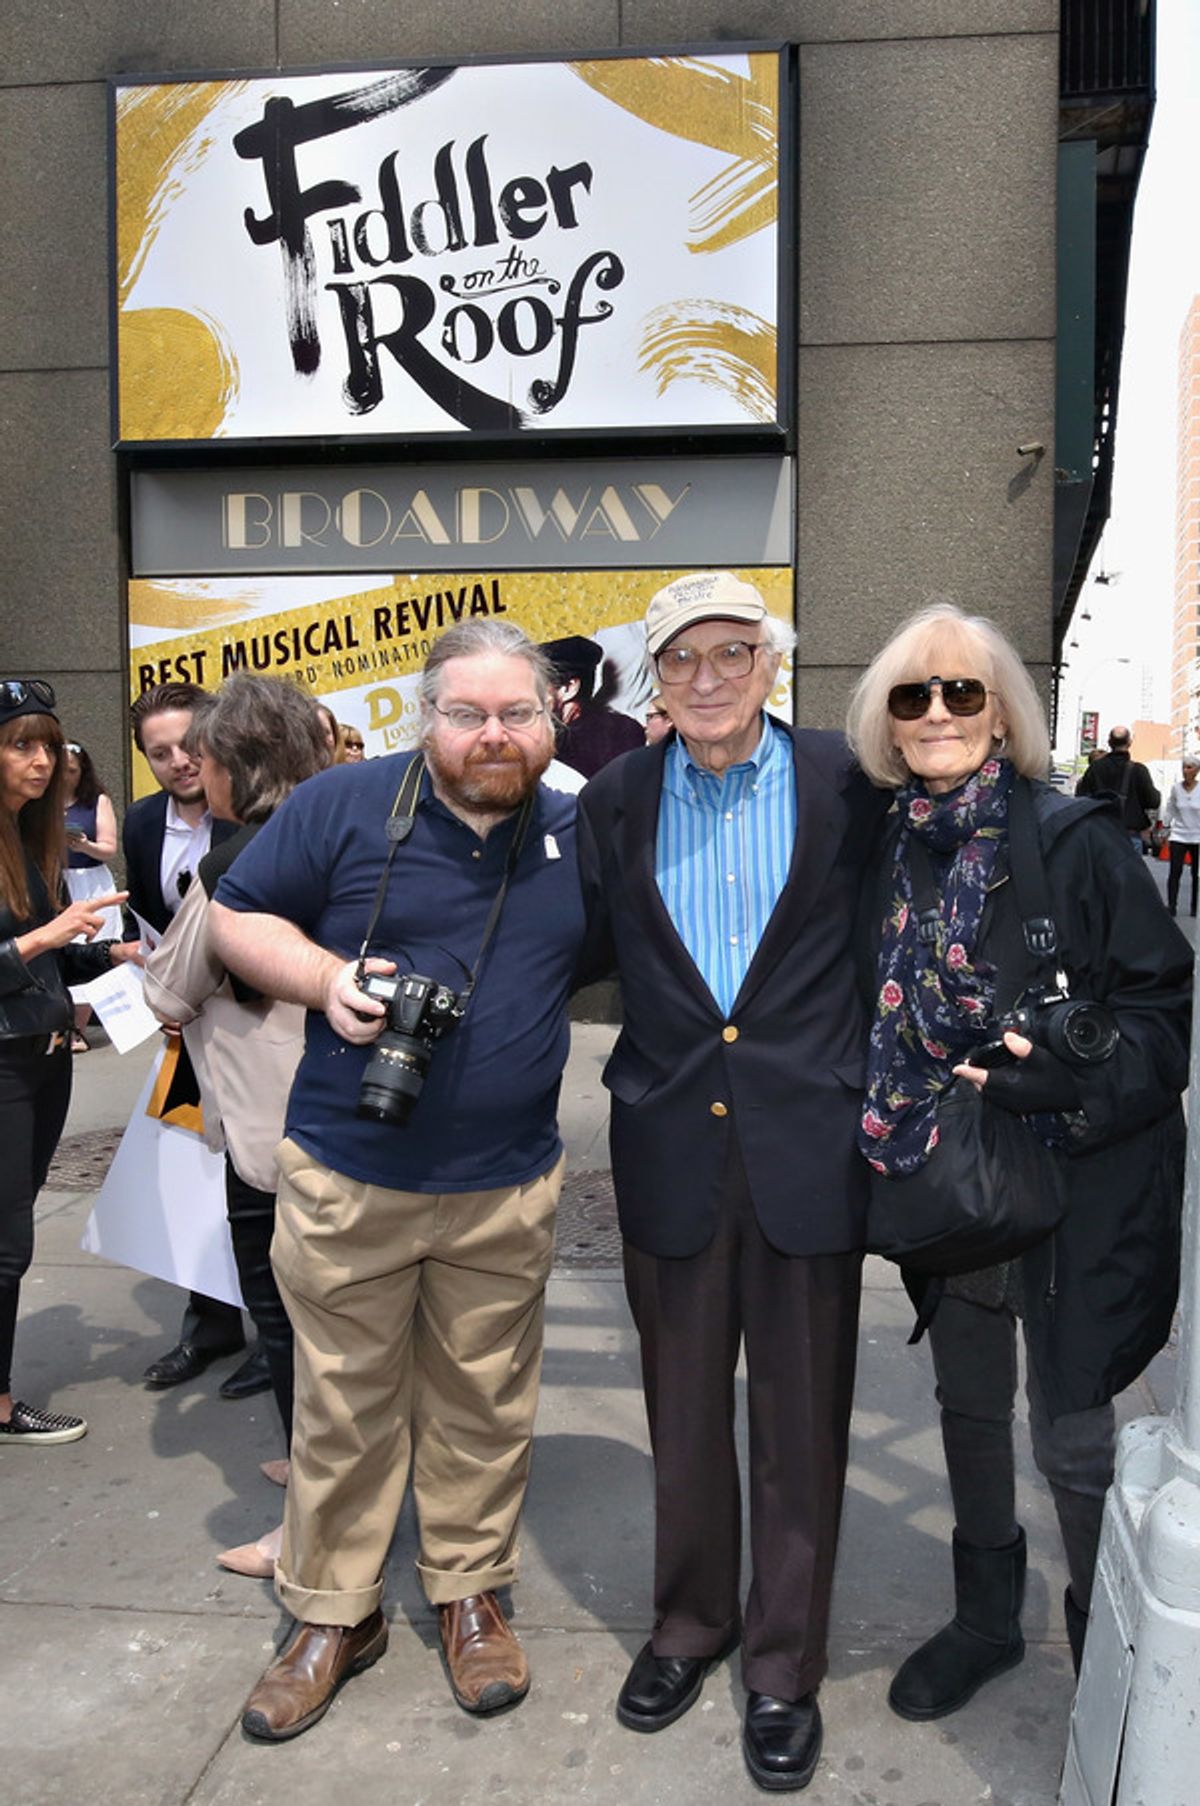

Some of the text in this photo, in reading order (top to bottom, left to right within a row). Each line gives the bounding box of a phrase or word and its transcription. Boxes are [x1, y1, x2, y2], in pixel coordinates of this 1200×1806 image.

[232, 66, 593, 376] Fiddler
[463, 245, 545, 290] on the
[325, 250, 624, 430] Roof
[222, 482, 692, 549] BROADWAY
[138, 579, 507, 693] BEST MUSICAL REVIVAL
